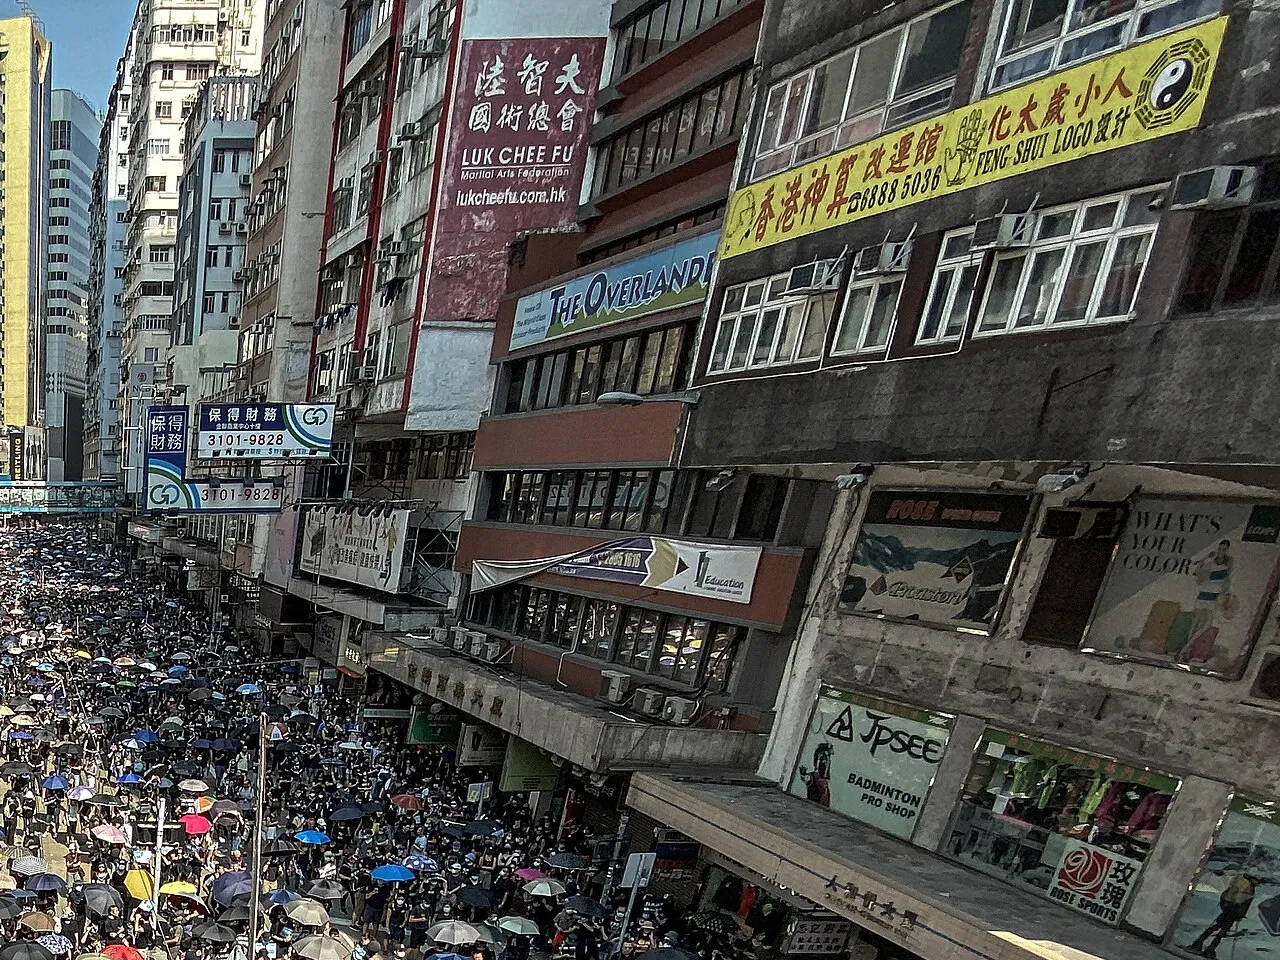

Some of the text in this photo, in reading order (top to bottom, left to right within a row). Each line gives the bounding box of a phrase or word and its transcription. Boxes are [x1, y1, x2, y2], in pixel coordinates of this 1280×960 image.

[468, 98, 584, 133] 國術總會
[987, 67, 1133, 144] 化太歲小人
[975, 105, 1130, 176] FENG SHUI LOGO 設計
[462, 145, 573, 166] LUK CHEE FU
[461, 166, 569, 181] Martial Arts Federation
[456, 185, 565, 207] lukcheefu.com.hk
[860, 165, 942, 212] 6888 5036
[550, 286, 582, 326] THE
[151, 414, 183, 432] 保得
[208, 407, 277, 423] 保得財務
[150, 433, 182, 451] 財務
[208, 434, 284, 446] 3101-9828
[201, 487, 280, 502] 3101-9828
[886, 500, 939, 521] ROSE
[1136, 511, 1222, 535] WHAT'S
[1132, 533, 1185, 553] YOUR
[704, 575, 744, 590] Education
[847, 773, 921, 808] BADMINTON
[860, 792, 916, 820] PRO SHOP
[1100, 859, 1136, 909] 玫瑰
[1049, 886, 1118, 922] ROSE SPORTS
